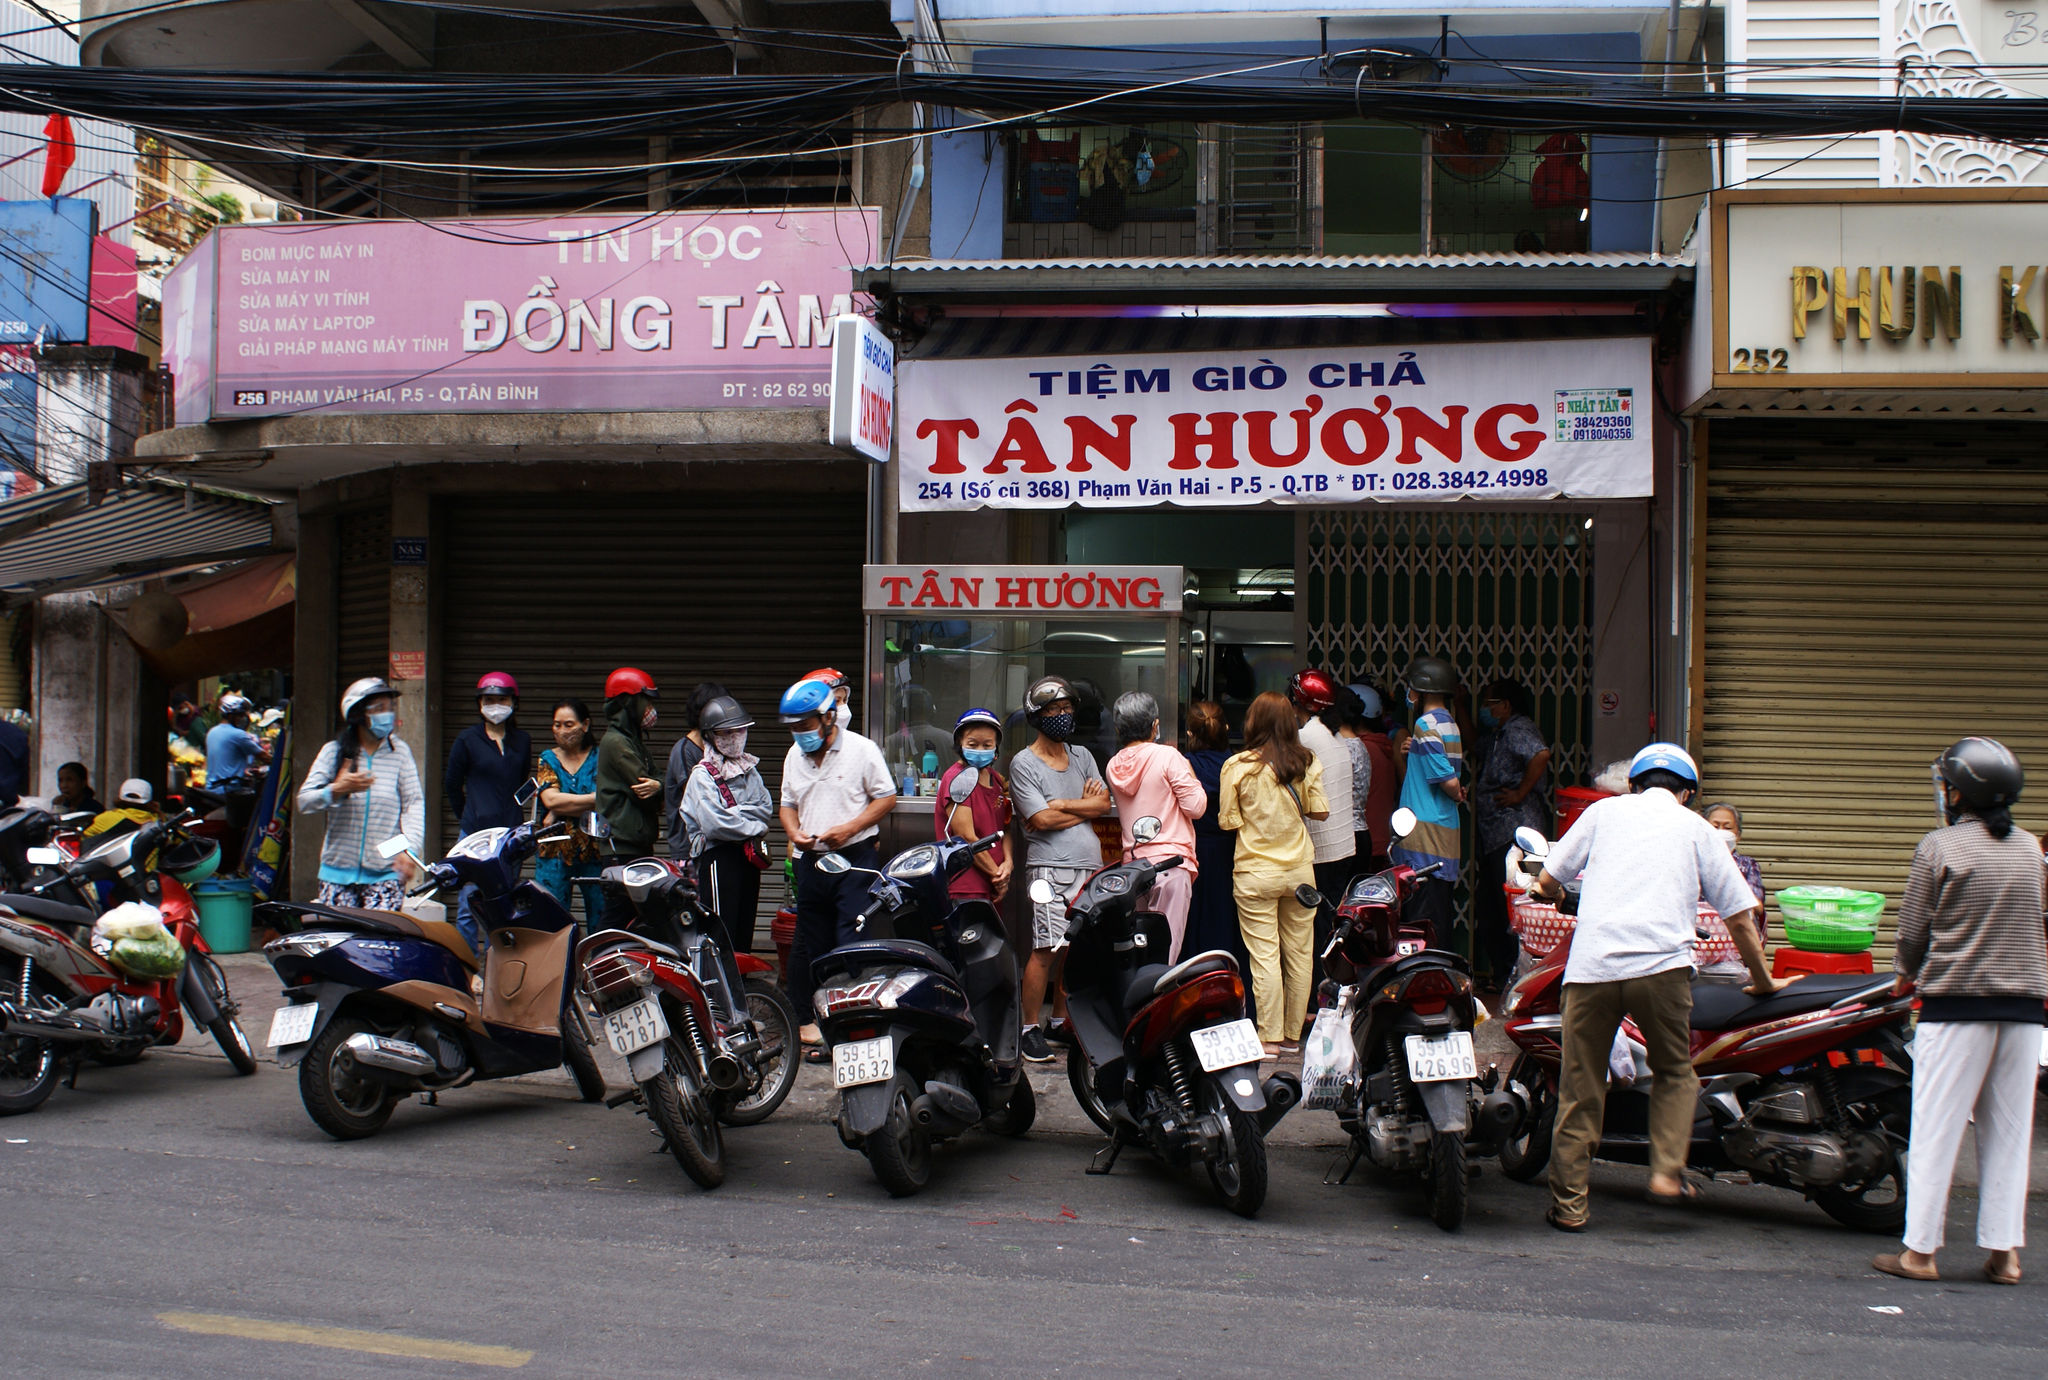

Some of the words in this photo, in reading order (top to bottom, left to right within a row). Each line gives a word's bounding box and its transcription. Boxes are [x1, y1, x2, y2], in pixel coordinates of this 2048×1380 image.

[241, 246, 275, 262] BƠM
[281, 245, 315, 262] MỰC
[320, 241, 353, 259] MÁY
[358, 244, 374, 257] IN
[549, 229, 631, 264] TIN
[651, 226, 762, 268] HỌC
[241, 267, 272, 285] SỬA
[276, 266, 310, 284] MÁY
[315, 269, 330, 283] IN
[240, 290, 271, 309] SỬA
[275, 290, 309, 308] MÁY
[314, 293, 329, 307] VI
[333, 289, 370, 306] TÍNH
[1792, 266, 1961, 341] PHUN
[1998, 266, 2048, 341] K
[239, 314, 271, 333] SỬA
[274, 314, 309, 332] MÁY
[313, 316, 375, 331] LAPTOP
[460, 276, 672, 353] ĐỒNG
[697, 279, 853, 350] TÂM
[239, 338, 270, 356] GIẢI
[274, 338, 317, 356] PHÁP
[321, 340, 368, 357] MẠNG
[373, 335, 407, 353] MÁY
[412, 335, 449, 352] TÍNH
[1732, 348, 1789, 373] 252
[1029, 363, 1170, 400] TIỆM
[1192, 358, 1287, 392] GIÒ
[1308, 352, 1426, 388] CHẢ
[237, 393, 265, 405] 256
[271, 389, 318, 407] PHẠM
[324, 386, 357, 403] VĂN
[401, 388, 424, 402] P.5
[497, 382, 538, 400] BÌNH
[723, 383, 746, 398] ĐT
[763, 383, 781, 398] 62
[788, 383, 807, 398] 62
[1567, 397, 1595, 416] NHẬT
[1598, 396, 1619, 413] TÂN
[916, 398, 1137, 475] TÂN
[1167, 394, 1547, 470] HƯƠNG
[1573, 428, 1631, 441] 0918040356
[1574, 416, 1631, 428] 38429360
[918, 482, 953, 500] 254
[961, 479, 994, 501] (Số
[998, 481, 1020, 499] cũ
[1027, 480, 1071, 500] 368)
[1078, 479, 1130, 501] Phạm
[1137, 478, 1172, 497] Văn
[1180, 477, 1210, 496] Hai
[1231, 476, 1262, 494] P.5
[1282, 475, 1328, 496] Q.TB
[1352, 473, 1385, 492] ĐT:
[1392, 469, 1548, 491] 028.3842.4998
[880, 569, 984, 608] TÂN
[995, 572, 1164, 609] HƯƠNG
[609, 1002, 652, 1034] 54-P1
[616, 1021, 657, 1053] 0787
[1201, 1025, 1245, 1049] 59-P1
[843, 1041, 881, 1063] 59-E1
[1203, 1040, 1259, 1068] 243.95
[838, 1059, 889, 1084] 696.32
[1415, 1056, 1472, 1078] 426.96
